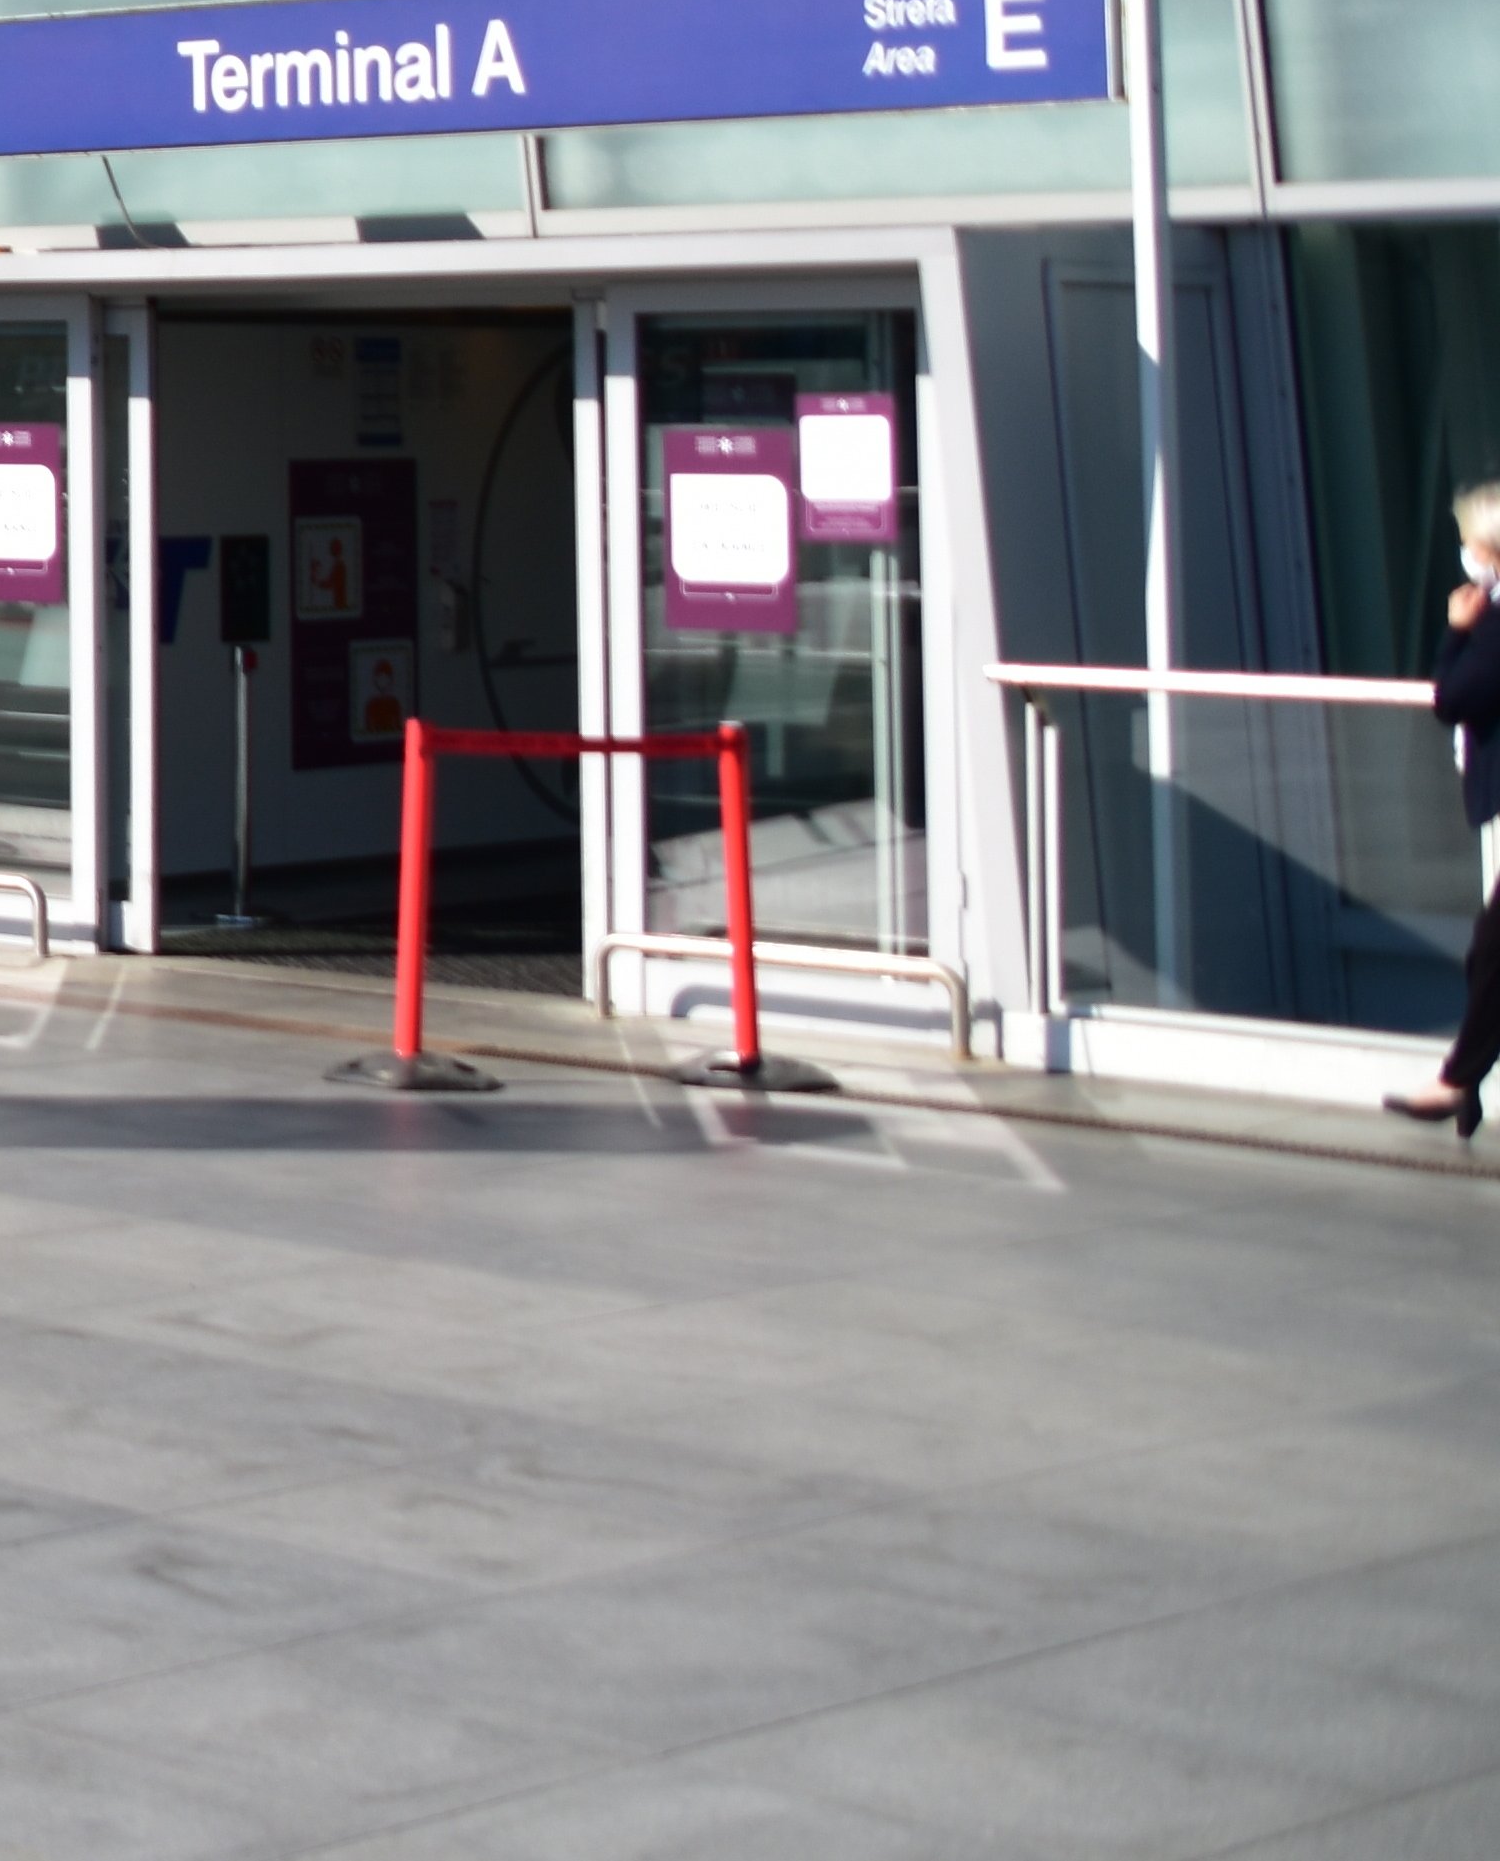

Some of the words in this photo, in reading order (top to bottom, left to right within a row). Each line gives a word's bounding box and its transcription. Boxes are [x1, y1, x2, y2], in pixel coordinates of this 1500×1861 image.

[176, 23, 451, 113] Terminal
[471, 19, 526, 96] A
[861, 41, 936, 76] Area
